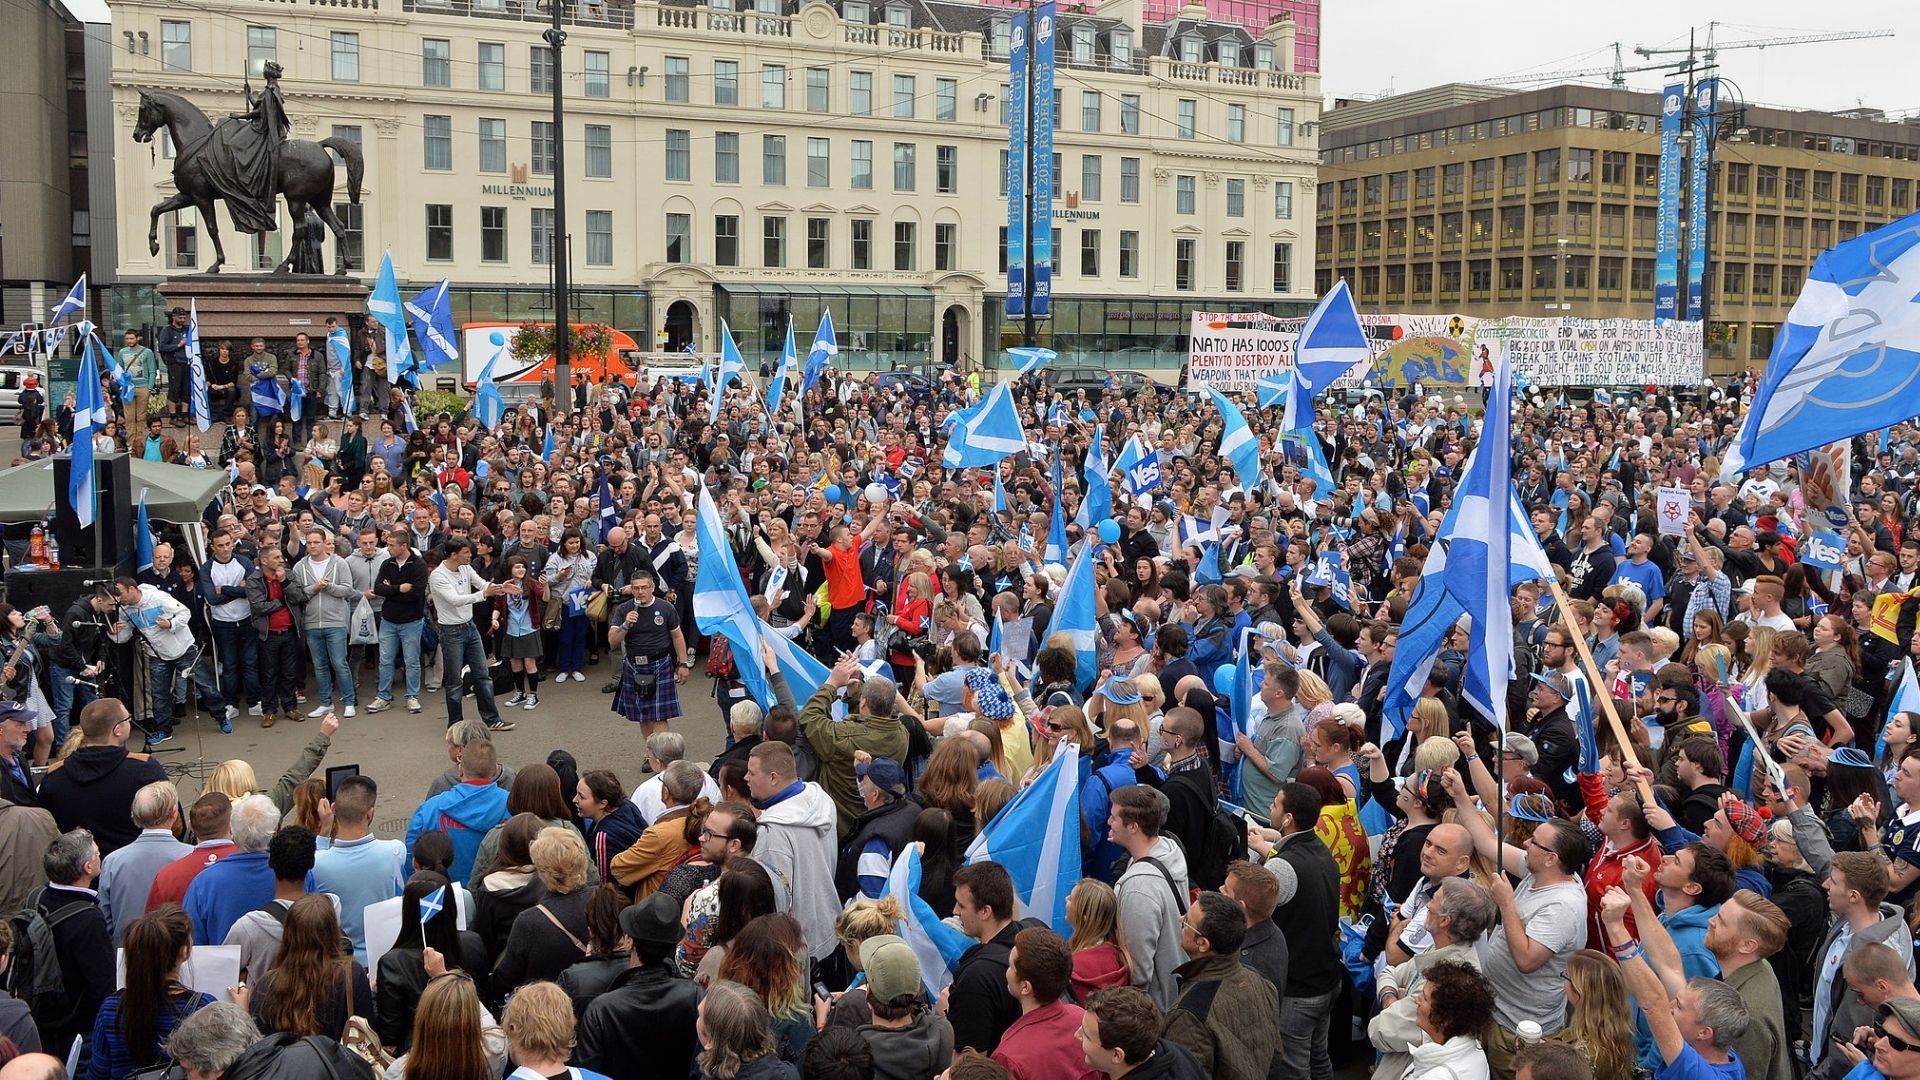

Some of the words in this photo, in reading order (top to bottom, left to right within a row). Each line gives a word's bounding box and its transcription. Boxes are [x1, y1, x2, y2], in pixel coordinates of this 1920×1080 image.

[1014, 70, 1022, 100] CUP
[1042, 62, 1050, 93] CUP
[1033, 63, 1042, 148] WELCOMES
[1012, 105, 1021, 153] RYDER
[1040, 97, 1049, 149] RYDER
[1660, 131, 1669, 195] WELCOMES
[1693, 126, 1702, 190] WELCOMES
[1012, 159, 1020, 190] 2014
[1040, 152, 1048, 186] 2014
[1668, 156, 1677, 196] RYDER
[482, 185, 555, 197] MILLENNIUM
[1012, 194, 1020, 222] THE
[1039, 190, 1048, 219] THE
[1667, 199, 1676, 224] 2014
[1052, 210, 1100, 220] ILLENNIUM
[1666, 226, 1675, 251] THE
[1199, 313, 1218, 321] STOP
[1238, 313, 1260, 321] RACIST
[1367, 316, 1392, 324] BOSNIA
[1563, 315, 1594, 328] BRISTOL
[1599, 318, 1617, 328] SAYS
[1621, 319, 1633, 328] YES
[1192, 336, 1228, 352] NATO
[1232, 338, 1254, 352] HAS
[1558, 327, 1573, 338] END
[1577, 329, 1598, 339] WARS
[1602, 328, 1617, 338] FOR
[1622, 329, 1651, 339] PROFIT
[1665, 330, 1703, 343] RESOURCES
[1368, 340, 1388, 351] RMS
[1510, 340, 1521, 351] BIG
[1530, 341, 1540, 352] OF
[1542, 341, 1556, 353] OUR
[1559, 340, 1577, 352] VITAL
[1580, 341, 1597, 351] CASH
[1599, 341, 1608, 351] ON
[1612, 340, 1632, 352] ARMS
[1636, 341, 1664, 352] INSTEAD
[1667, 341, 1674, 352] OF
[1677, 341, 1688, 354] LIFE
[1235, 355, 1275, 367] DESTROY
[1510, 352, 1540, 363] BREAK
[1545, 353, 1558, 363] THE
[1562, 352, 1593, 363] CHAINS
[1598, 352, 1640, 363] SCOTLAND
[1645, 353, 1662, 362] VOTE
[1668, 353, 1678, 363] YES
[1192, 369, 1231, 381] WEAPONS
[1234, 369, 1256, 380] THAT
[1260, 369, 1279, 379] CAN
[1574, 363, 1589, 374] AND
[1594, 364, 1612, 374] SOLD
[1617, 363, 1631, 374] FOR
[1636, 363, 1667, 374] ENGLISH
[1234, 382, 1243, 390] US
[1244, 382, 1258, 391] BUS
[1546, 375, 1558, 386] YES
[1562, 375, 1571, 386] TO
[1575, 375, 1610, 386] FREEDOM
[1615, 375, 1642, 385] SOCIAL
[1645, 375, 1671, 386] JSTICE
[900, 464, 914, 476] Yes
[1130, 461, 1159, 490] Yes
[1825, 509, 1847, 521] Yes
[1808, 536, 1841, 565] Yes
[1315, 556, 1331, 581] Ye
